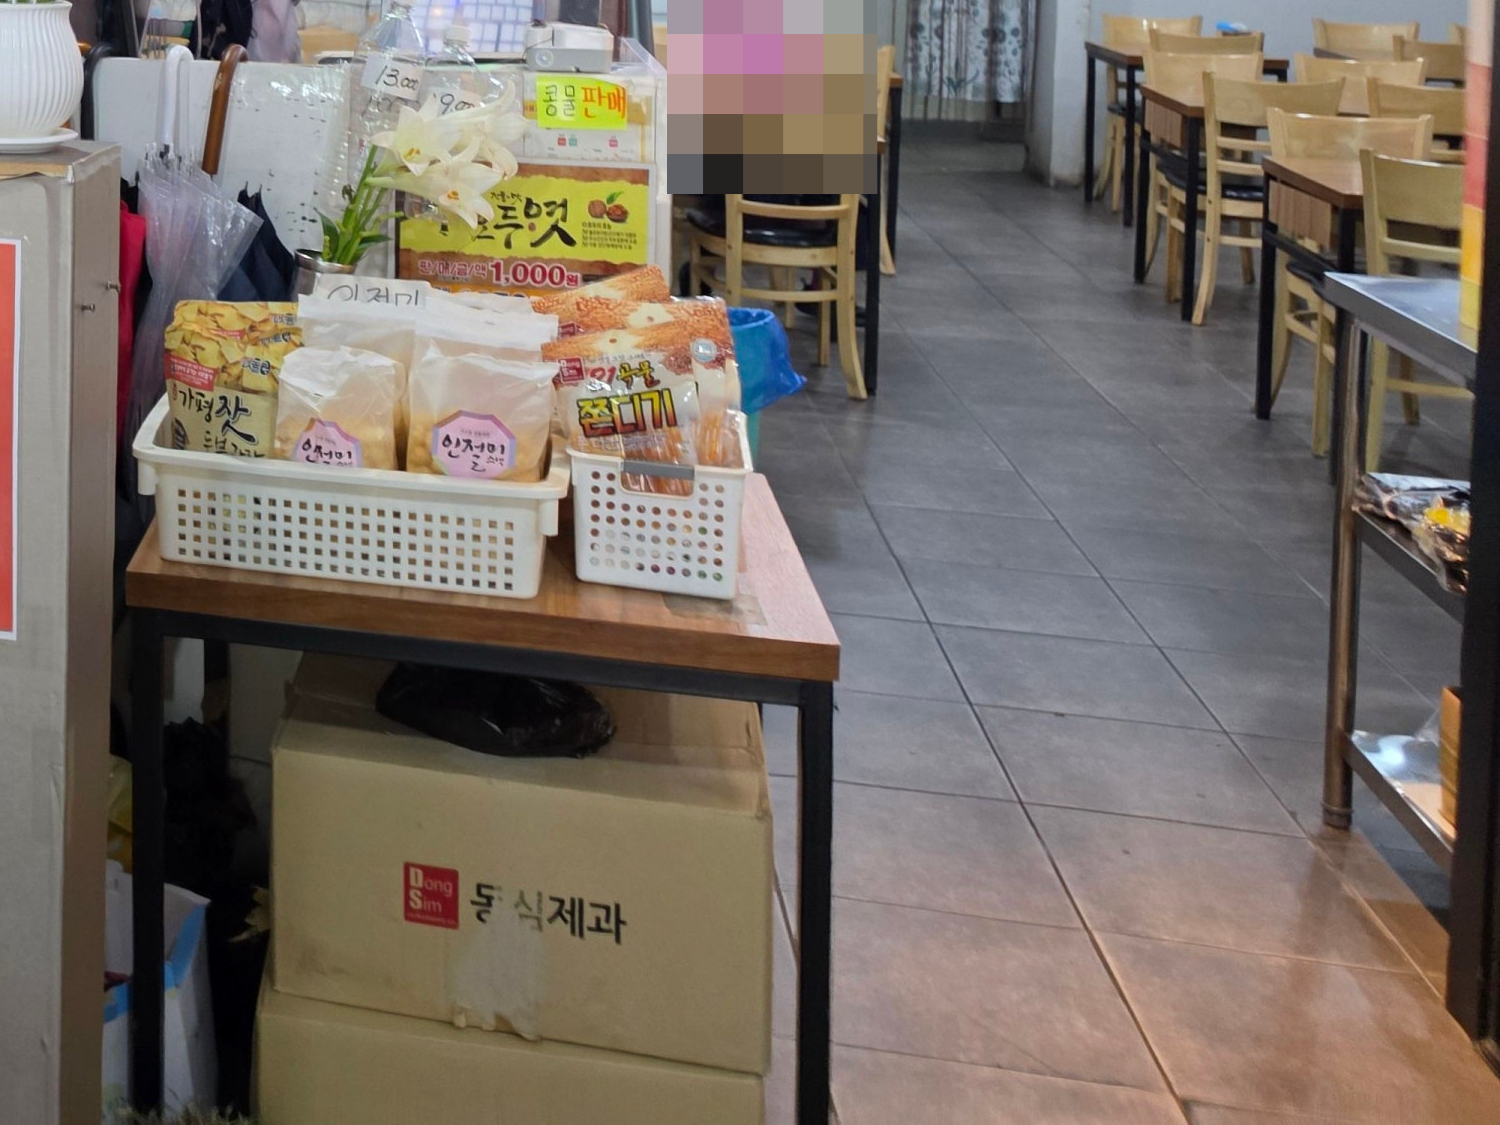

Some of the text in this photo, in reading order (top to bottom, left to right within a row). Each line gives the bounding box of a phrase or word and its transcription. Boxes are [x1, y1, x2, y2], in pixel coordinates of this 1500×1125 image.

[581, 85, 627, 120] 판매
[576, 387, 678, 439] 쫀디기
[442, 434, 505, 473] 인절미
[409, 866, 454, 897] Dong
[409, 888, 443, 915] Sim
